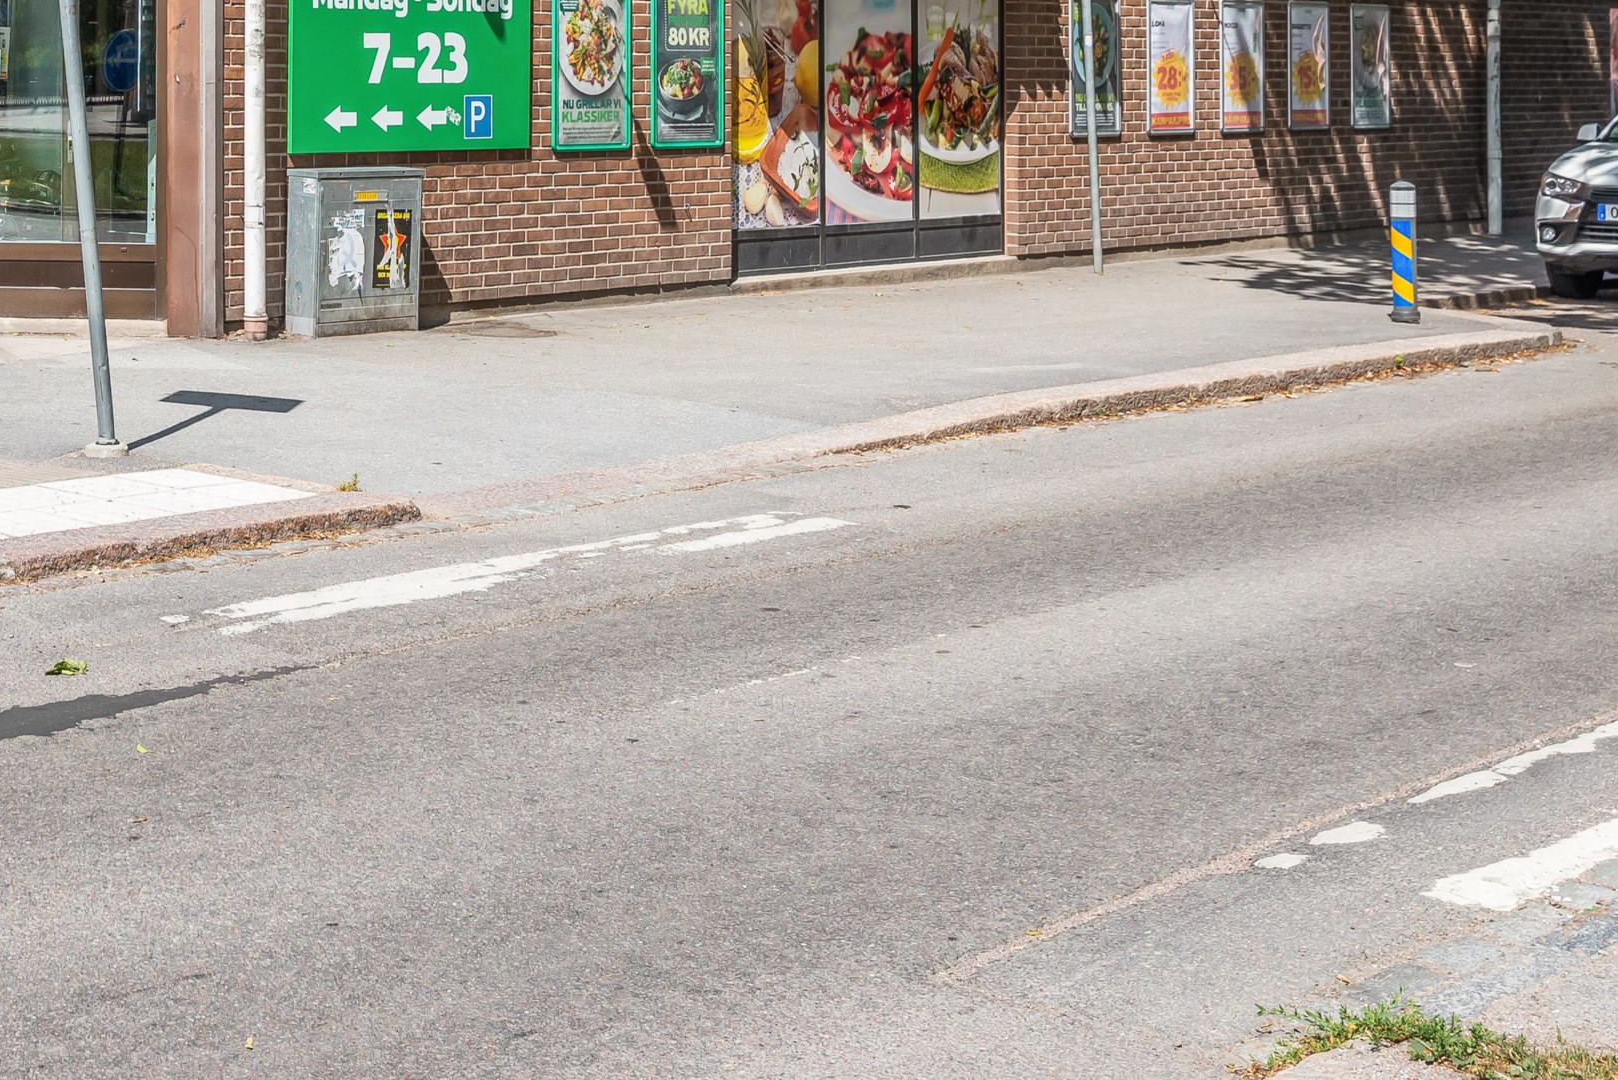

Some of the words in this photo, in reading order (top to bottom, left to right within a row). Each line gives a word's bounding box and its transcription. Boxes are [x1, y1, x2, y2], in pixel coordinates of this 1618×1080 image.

[668, 27, 687, 46] 80
[688, 27, 710, 46] KR
[362, 32, 469, 85] 7-23
[562, 99, 574, 110] NU
[576, 99, 612, 110] GRILLAR
[613, 98, 621, 109] VI
[470, 100, 486, 134] P
[562, 110, 620, 123] KLASSIKER
